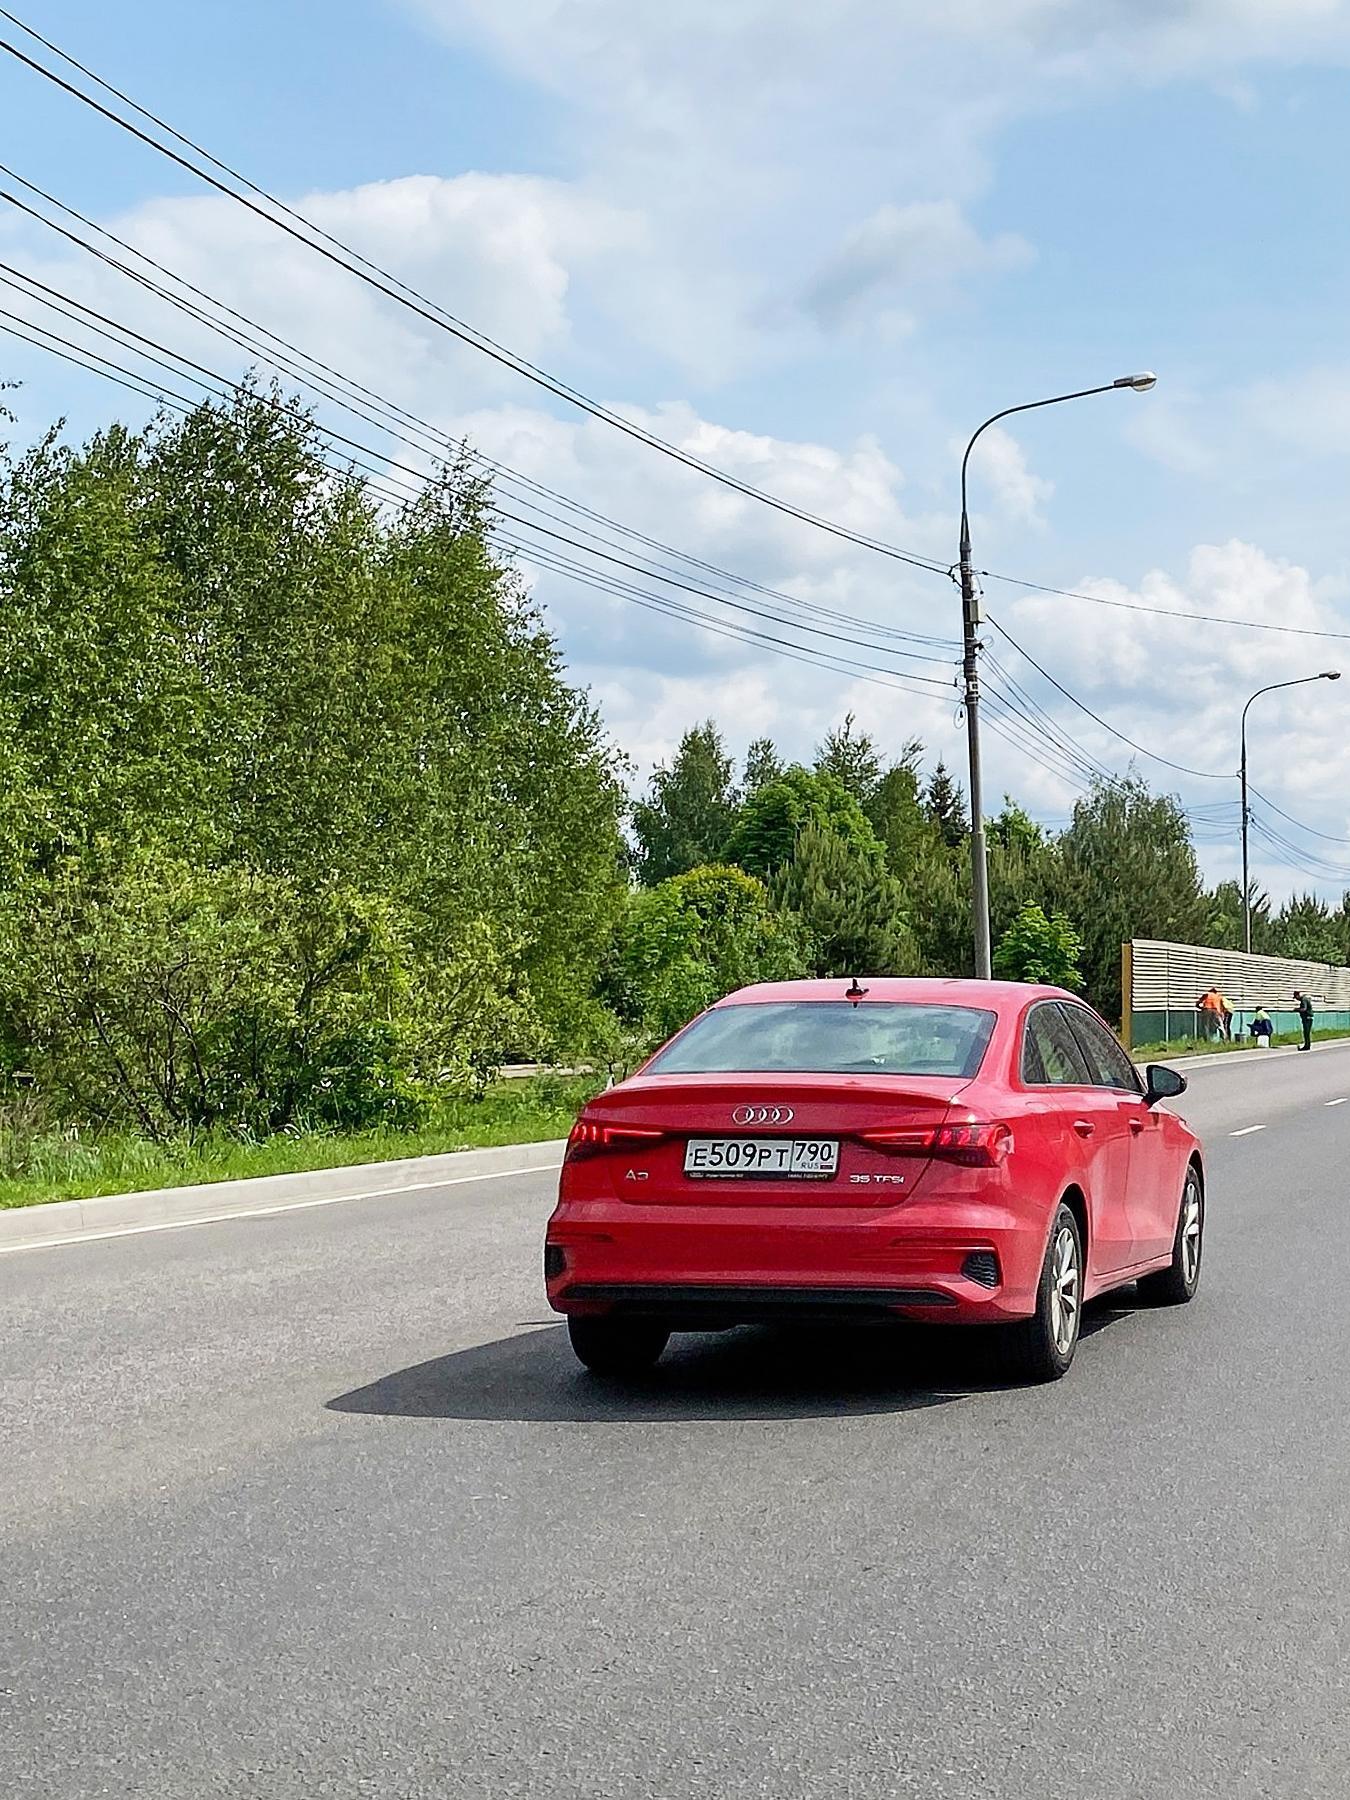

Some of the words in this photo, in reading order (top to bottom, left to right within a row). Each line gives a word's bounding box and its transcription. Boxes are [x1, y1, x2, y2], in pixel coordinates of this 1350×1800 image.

[795, 1142, 833, 1161] 790
[801, 1162, 819, 1170] RUS
[849, 1174, 871, 1183] 35
